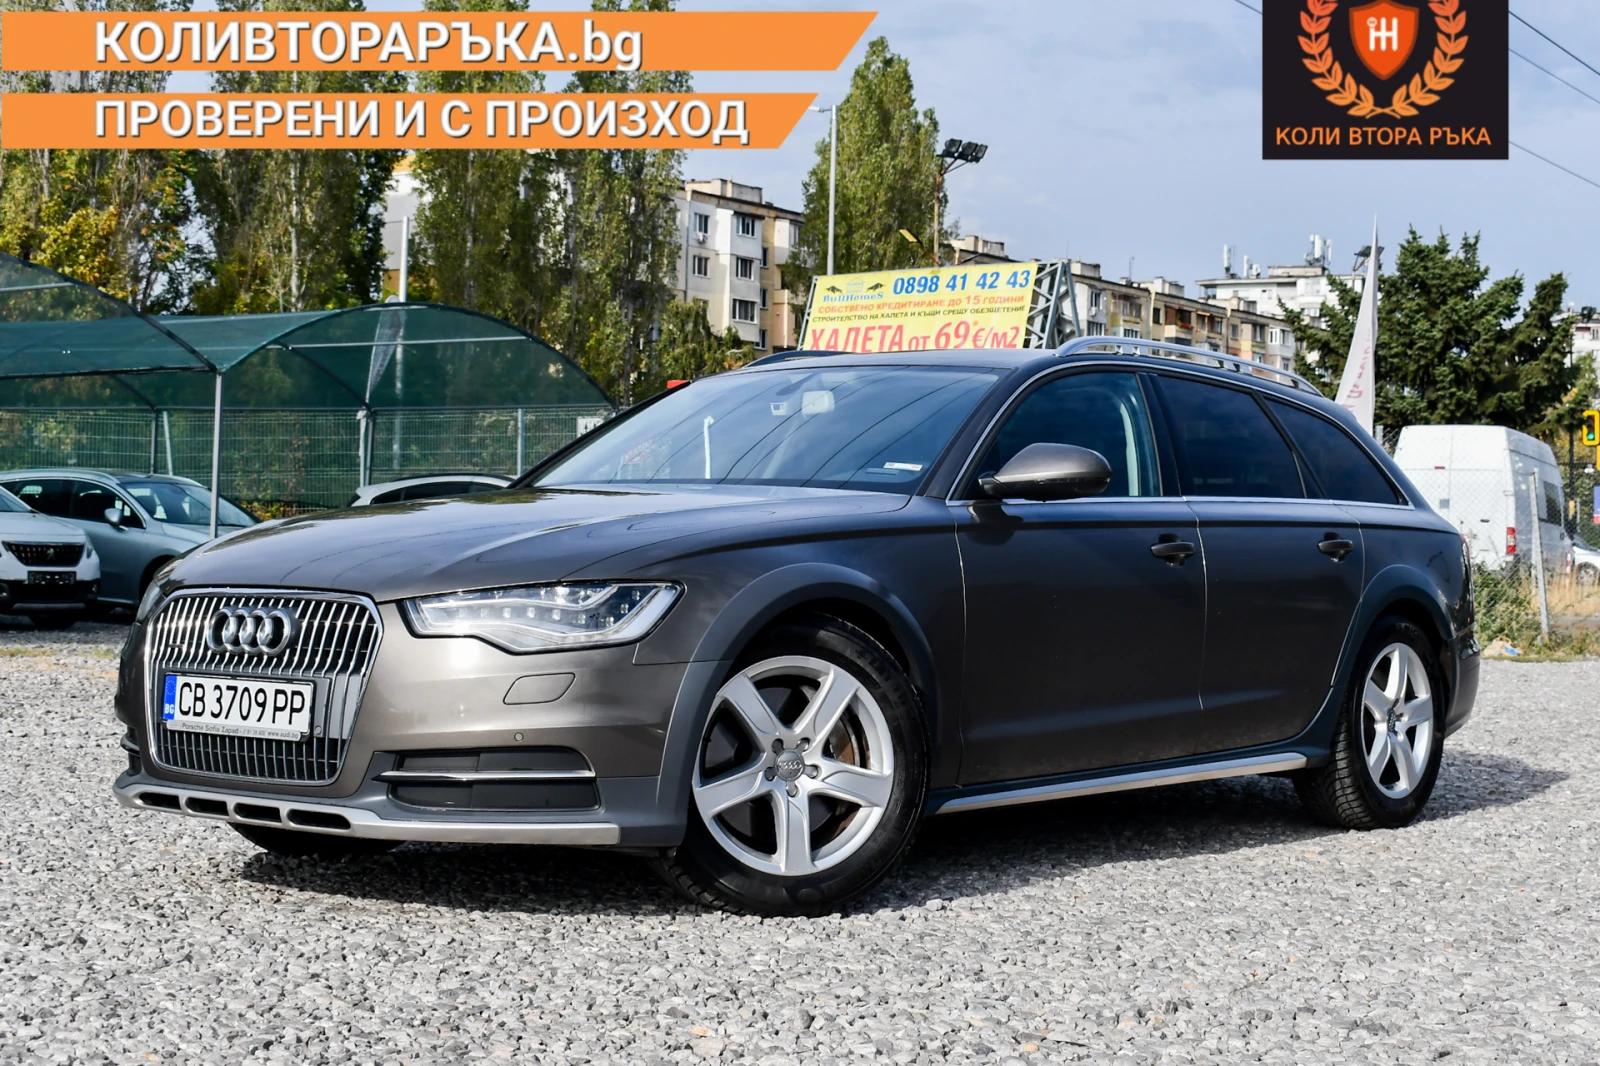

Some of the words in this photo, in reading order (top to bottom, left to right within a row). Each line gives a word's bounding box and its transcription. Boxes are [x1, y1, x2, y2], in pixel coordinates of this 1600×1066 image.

[892, 275, 940, 295] 0898
[946, 273, 968, 292] 41
[975, 271, 1000, 290] 42
[1006, 269, 1031, 289] 43
[818, 303, 874, 314] СОБСТВЕНО
[876, 299, 945, 311] КРЕДИТИРАНЕ
[947, 298, 962, 307] ДО
[965, 295, 981, 305] 15
[812, 314, 868, 323] СТРОИТЕЛСТВО
[942, 308, 968, 316] СРЕЩУ
[810, 324, 904, 353] ХАЛЕТА
[165, 704, 175, 714] BG
[182, 722, 204, 731] Porsche
[205, 724, 220, 732] Sofia
